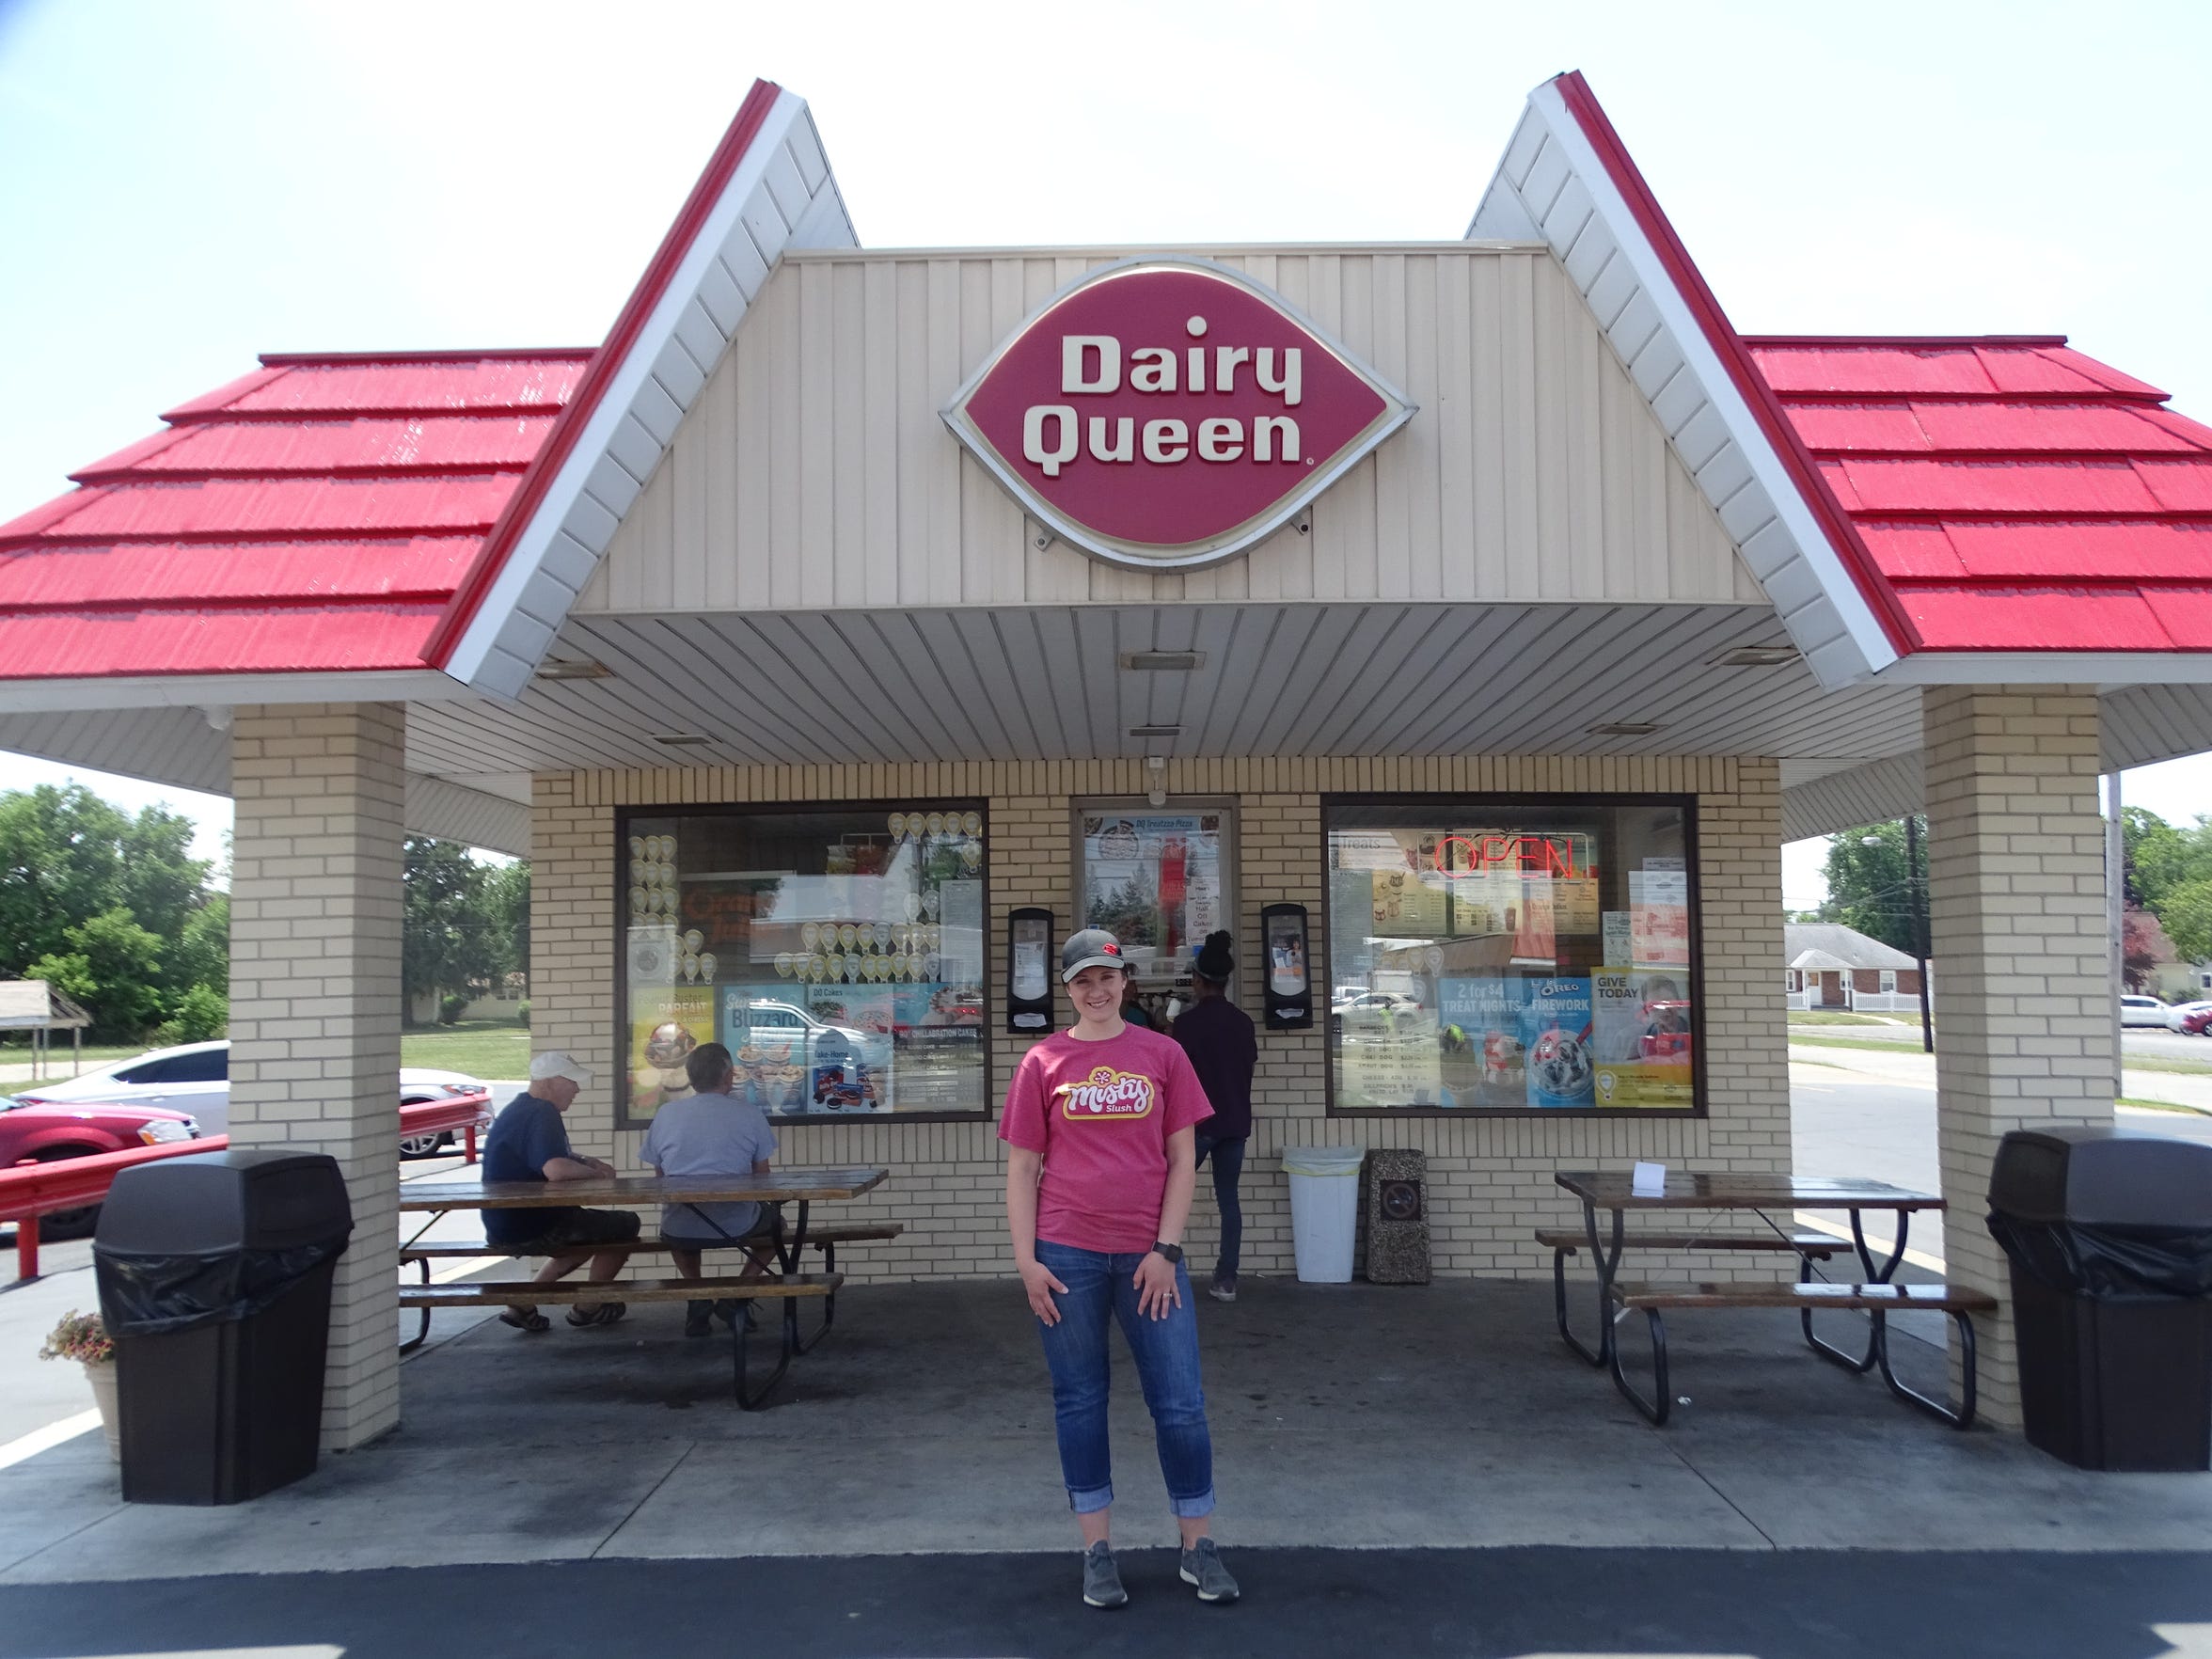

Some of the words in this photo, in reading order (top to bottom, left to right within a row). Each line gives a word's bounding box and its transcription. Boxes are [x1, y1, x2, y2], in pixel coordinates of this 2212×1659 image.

[1061, 316, 1303, 406] Dairy
[1022, 404, 1302, 477] Queen
[1176, 818, 1193, 828] Pizza
[1341, 837, 1381, 849] Treats
[1434, 836, 1573, 879] OPEN
[1598, 977, 1627, 988] GIVE
[813, 988, 823, 998] DQ
[824, 988, 843, 997] Cakes
[1458, 984, 1467, 999] 2
[1469, 984, 1486, 1000] for
[1489, 983, 1504, 998] $4
[1540, 984, 1580, 997] OREO
[1598, 988, 1638, 999] TODAY
[658, 1002, 707, 1016] PARFAIT
[1442, 1000, 1479, 1013] TREAT
[1481, 999, 1522, 1012] NIGHTS
[1532, 999, 1589, 1012] FIREWORK
[732, 1008, 798, 1028] Blizzard
[957, 1028, 977, 1037] CAKES
[1067, 1077, 1150, 1114] Misty
[1105, 1104, 1132, 1113] Slush
